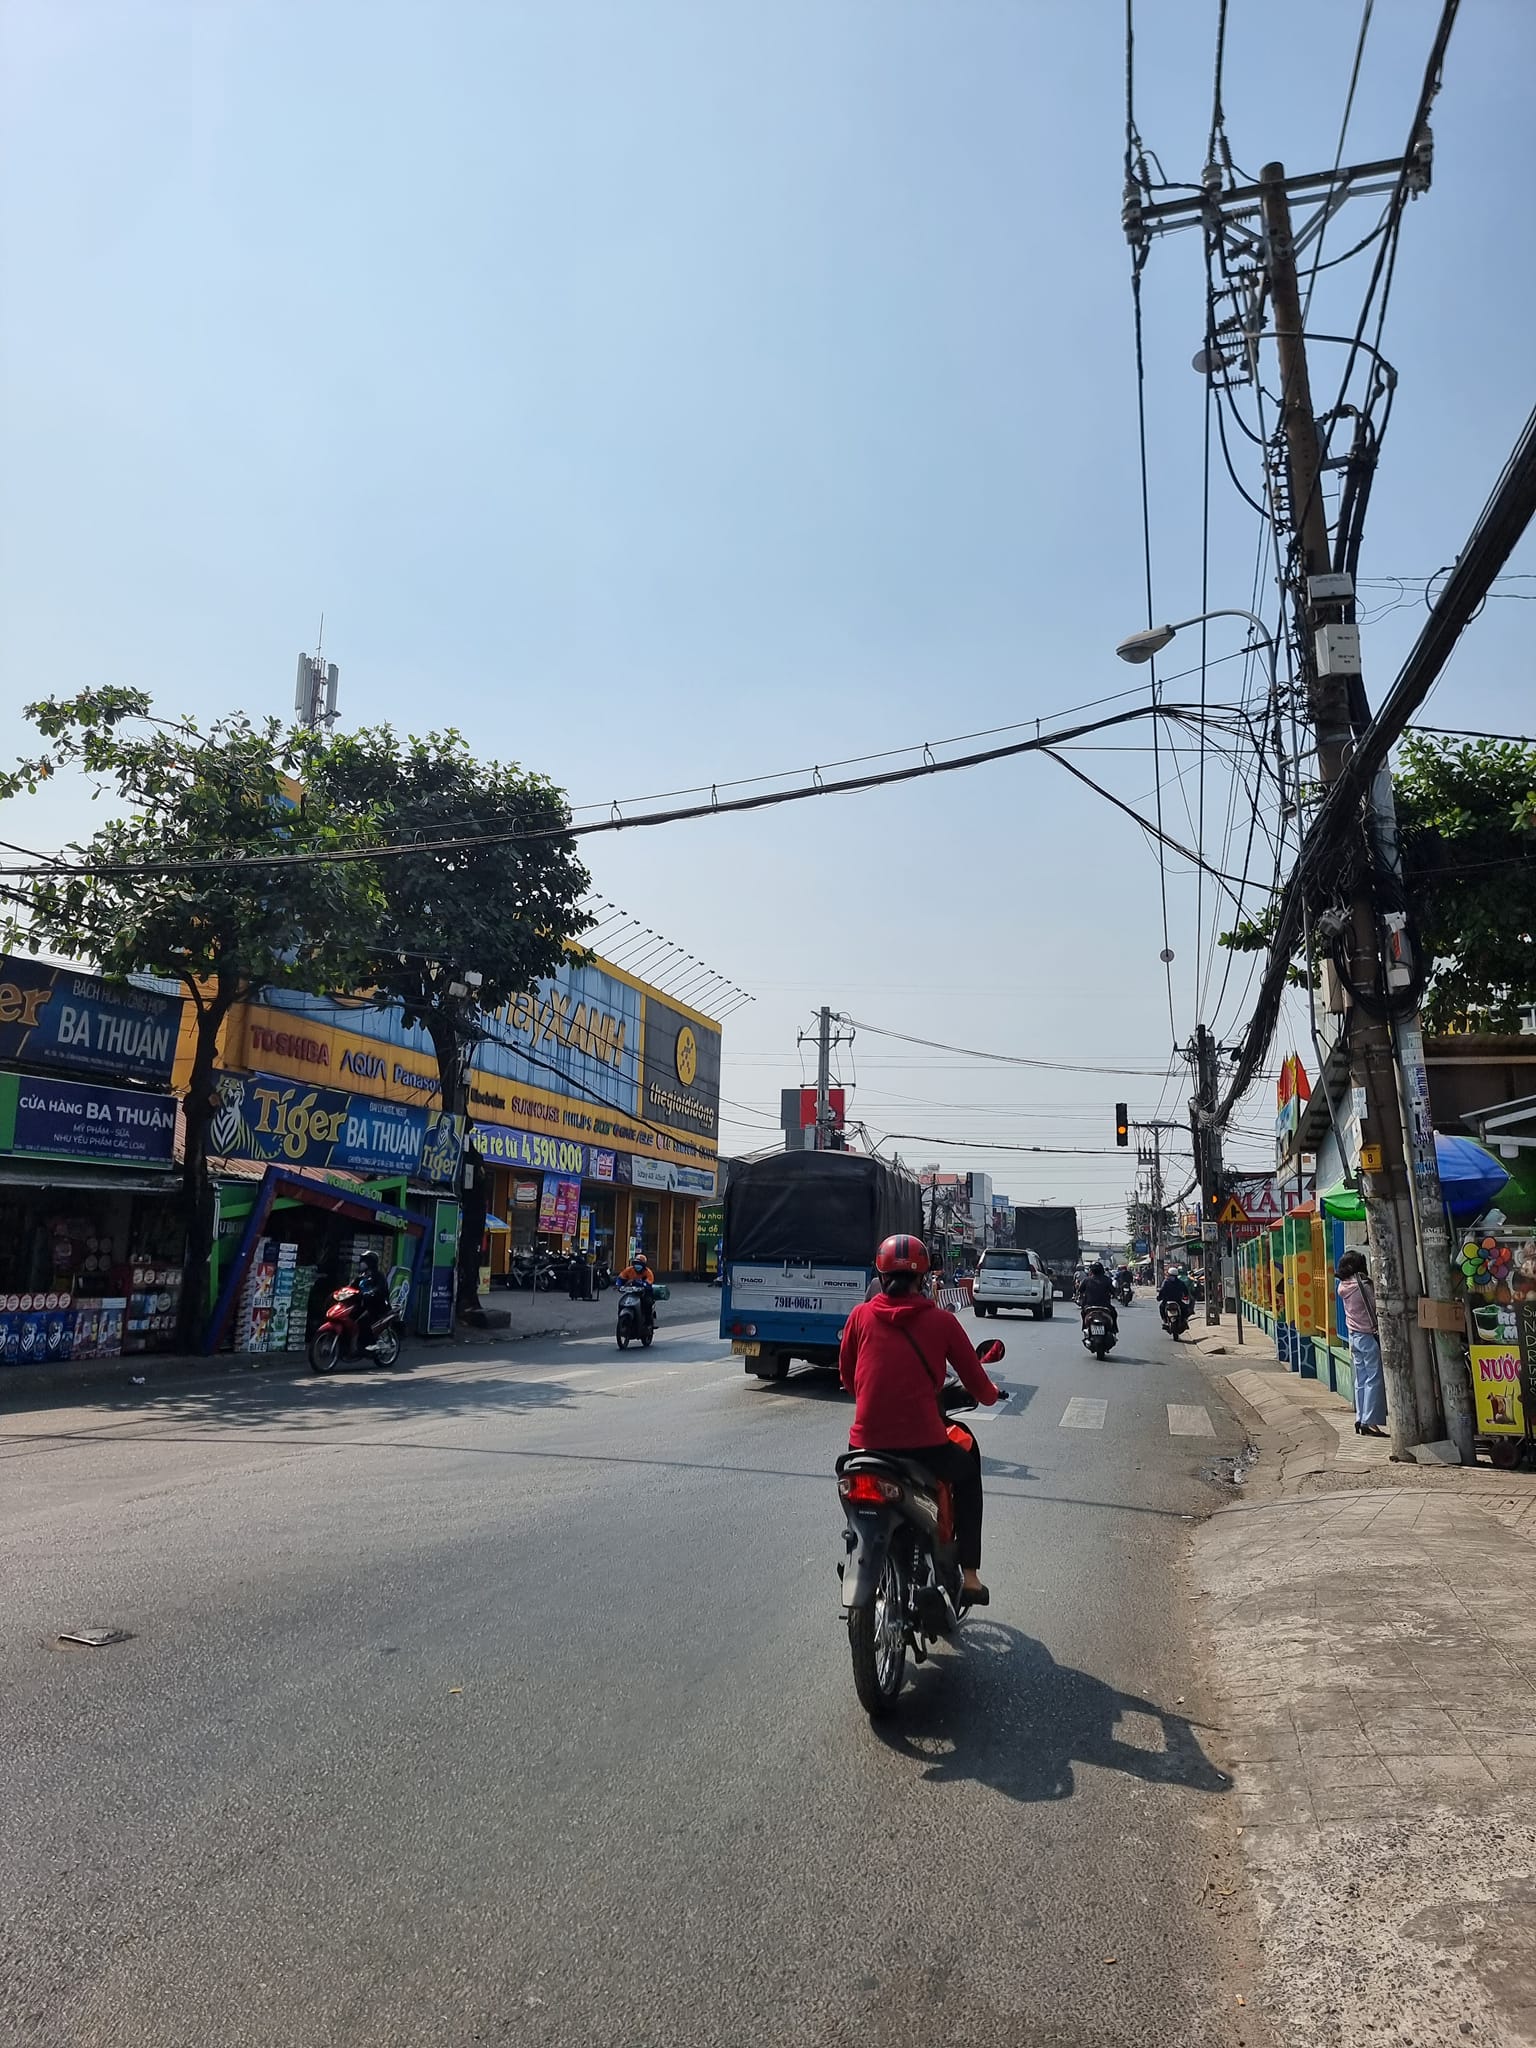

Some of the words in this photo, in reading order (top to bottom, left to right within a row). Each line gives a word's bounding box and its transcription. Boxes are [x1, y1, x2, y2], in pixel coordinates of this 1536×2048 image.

[57, 1006, 90, 1048] BA
[97, 1014, 170, 1065] THUẬN
[250, 1025, 330, 1067] TOSHIBA
[19, 1093, 46, 1111] CỬA
[49, 1098, 83, 1115] HÀNG
[86, 1102, 112, 1122] BA
[116, 1106, 174, 1132] THUẬN
[253, 1088, 347, 1159] Tiger
[511, 1096, 560, 1122] SUNHOUSE
[346, 1117, 368, 1149] BA
[371, 1119, 421, 1160] THUẬN
[521, 1134, 583, 1174] 4.590.000
[1368, 1153, 1374, 1163] 8
[422, 1143, 457, 1181] Tiger
[740, 1277, 764, 1285] THACO
[823, 1280, 859, 1288] FRONTIER
[774, 1296, 823, 1311] 79H-008.71
